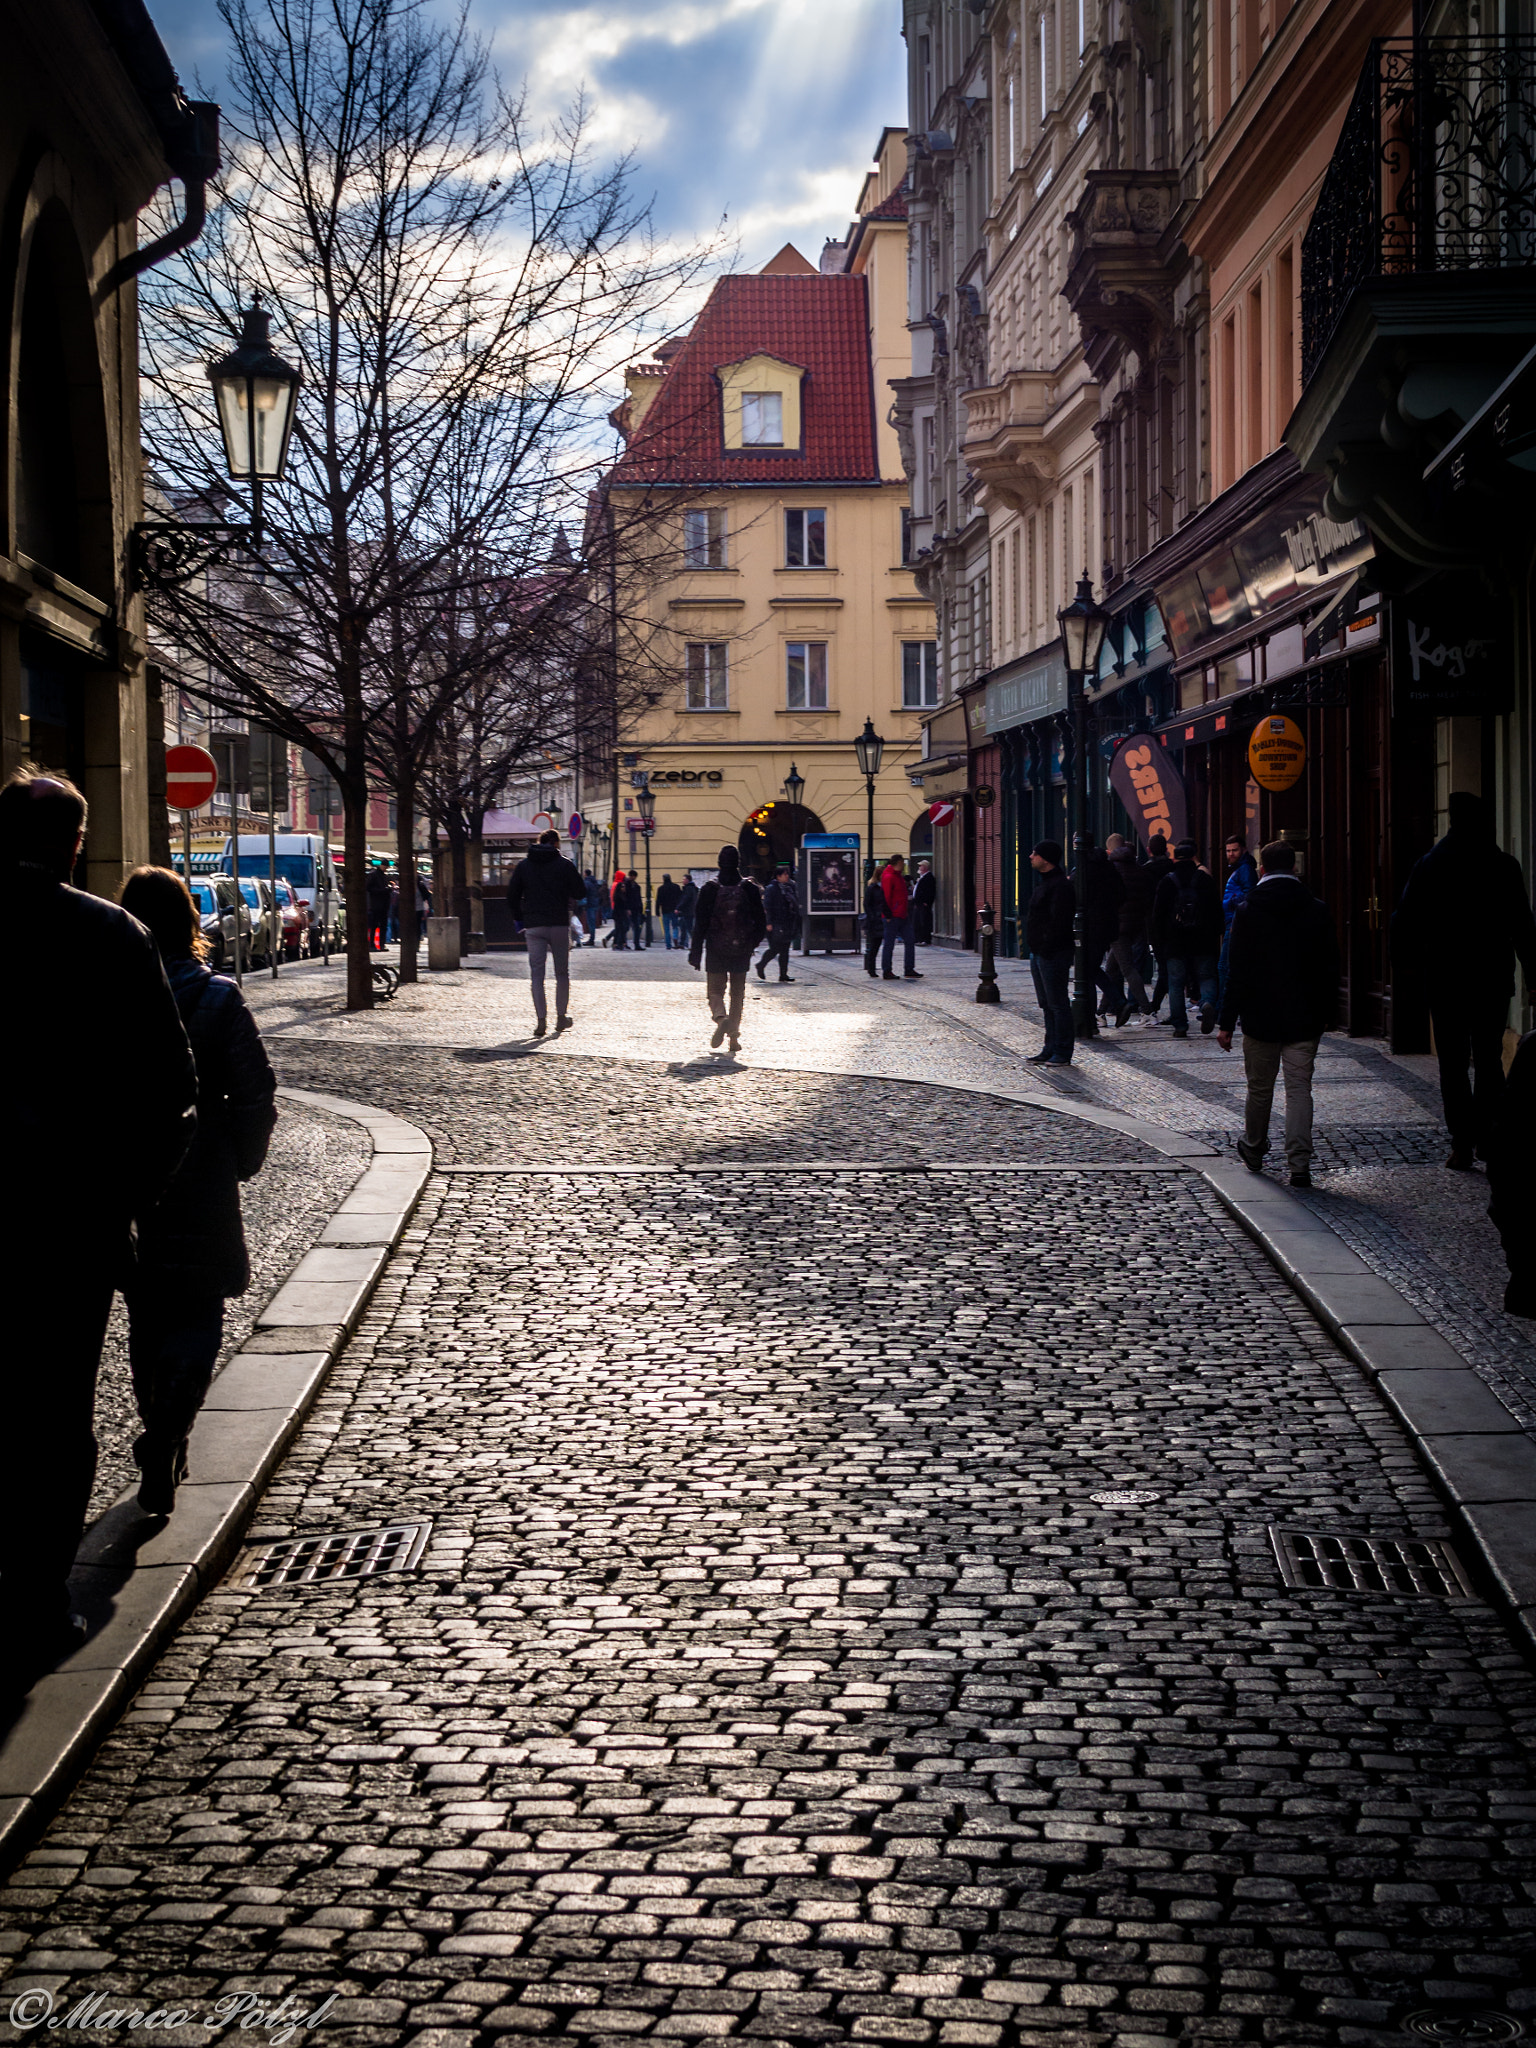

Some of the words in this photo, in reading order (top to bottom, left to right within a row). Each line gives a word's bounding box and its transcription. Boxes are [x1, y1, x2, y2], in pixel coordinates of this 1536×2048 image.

[1409, 691, 1430, 701] FISH
[1258, 753, 1298, 762] DOWNTOWN
[1269, 762, 1287, 771] SHOP
[650, 769, 723, 782] zebra
